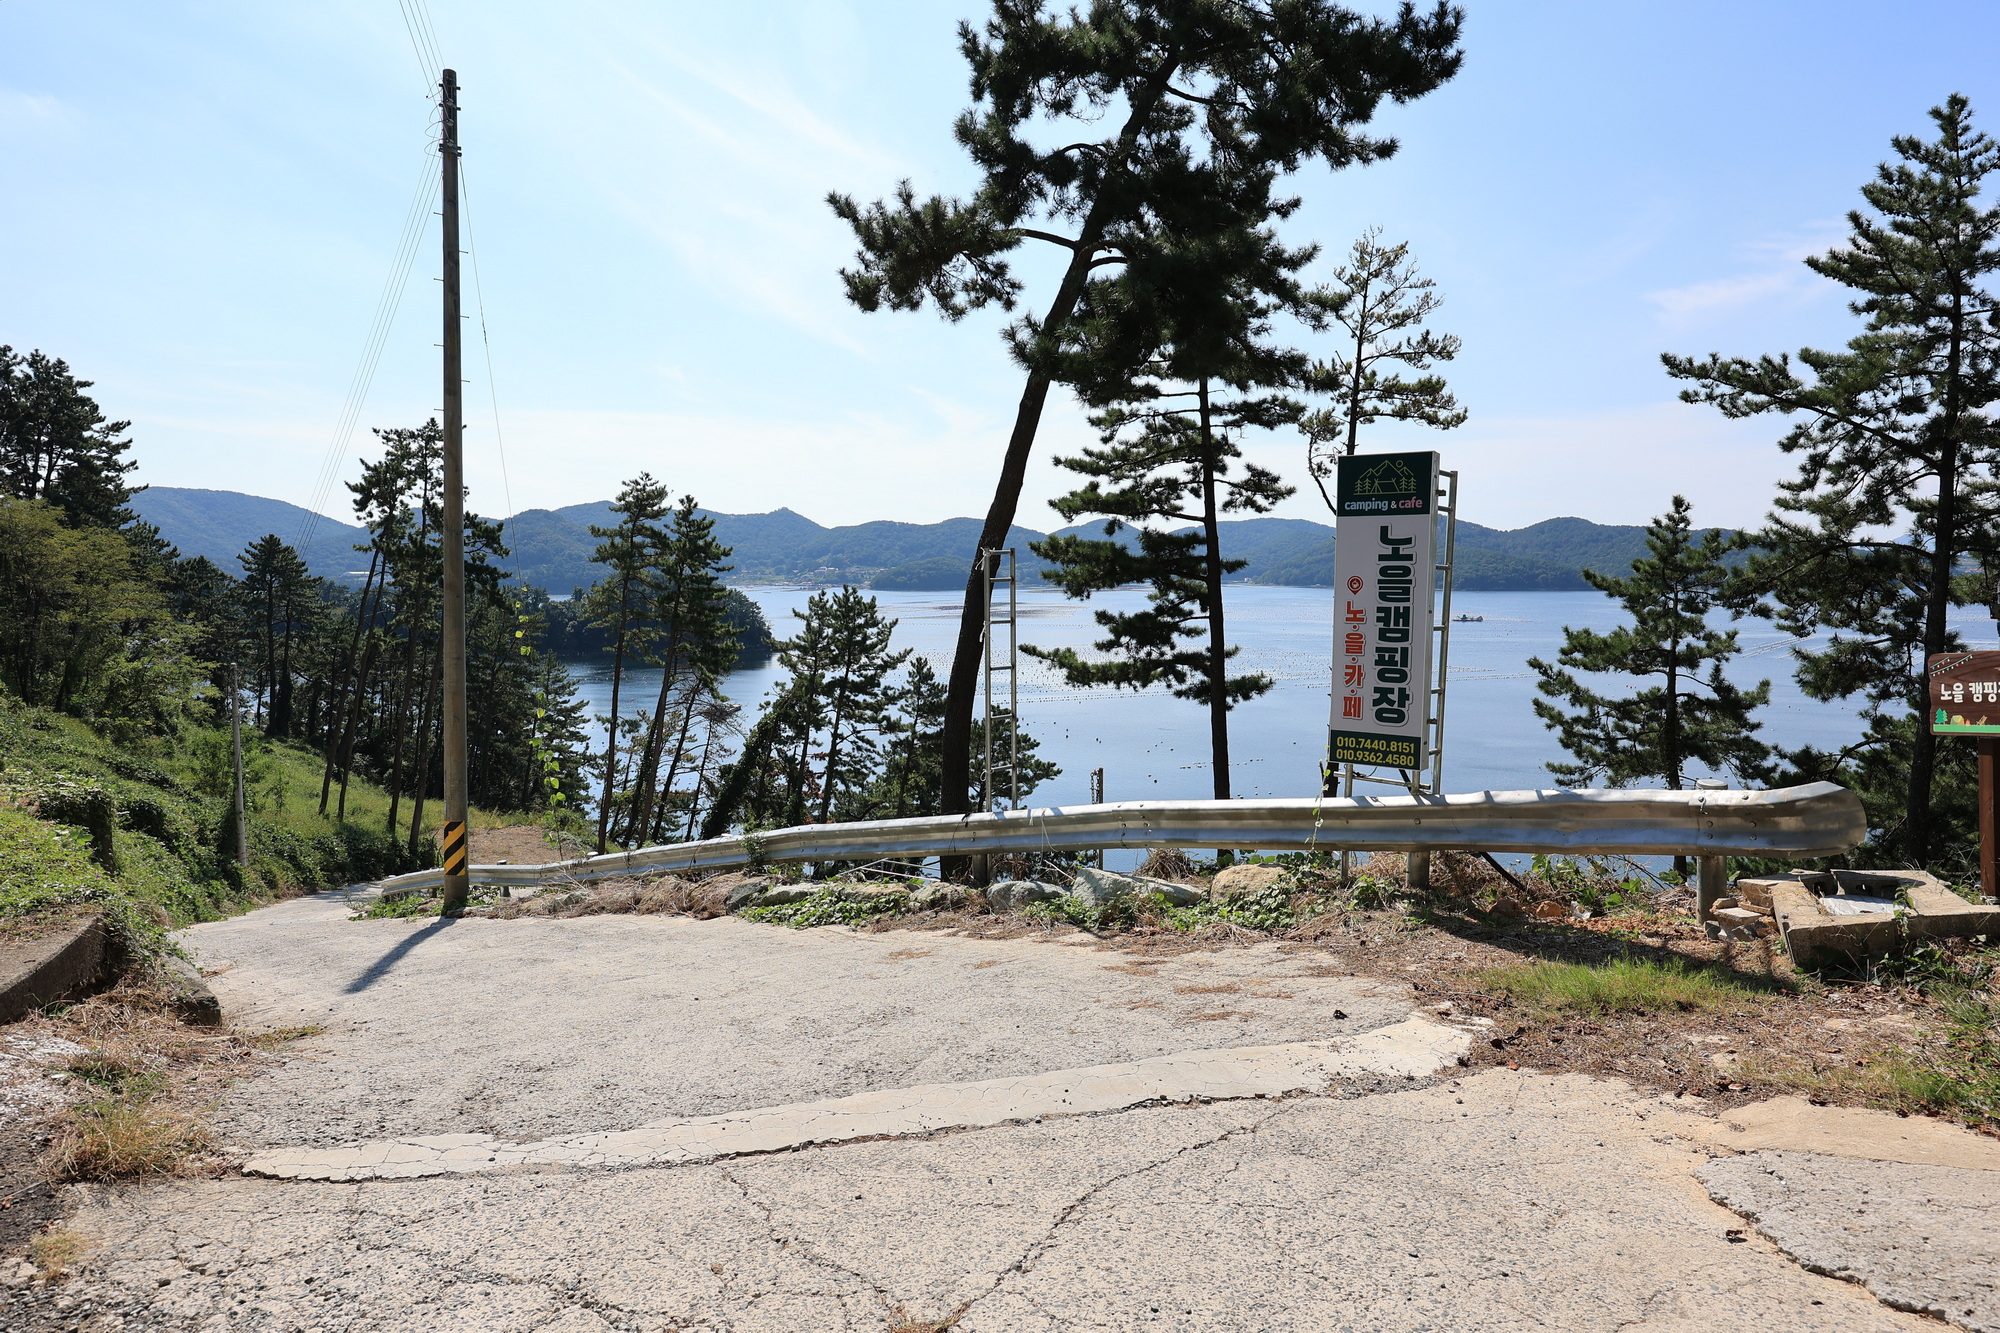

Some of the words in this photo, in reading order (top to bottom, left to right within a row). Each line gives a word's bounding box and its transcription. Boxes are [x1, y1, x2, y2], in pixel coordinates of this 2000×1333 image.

[1344, 497, 1389, 511] camping
[1390, 500, 1397, 509] &
[1398, 496, 1423, 509] cafe
[1372, 525, 1414, 724] 노을캠핑장
[1940, 682, 1965, 703] 노을
[1968, 681, 2000, 703] 캠핑
[1336, 736, 1415, 754] 010.7440.8151
[1335, 749, 1415, 767] 010.9362.4580
